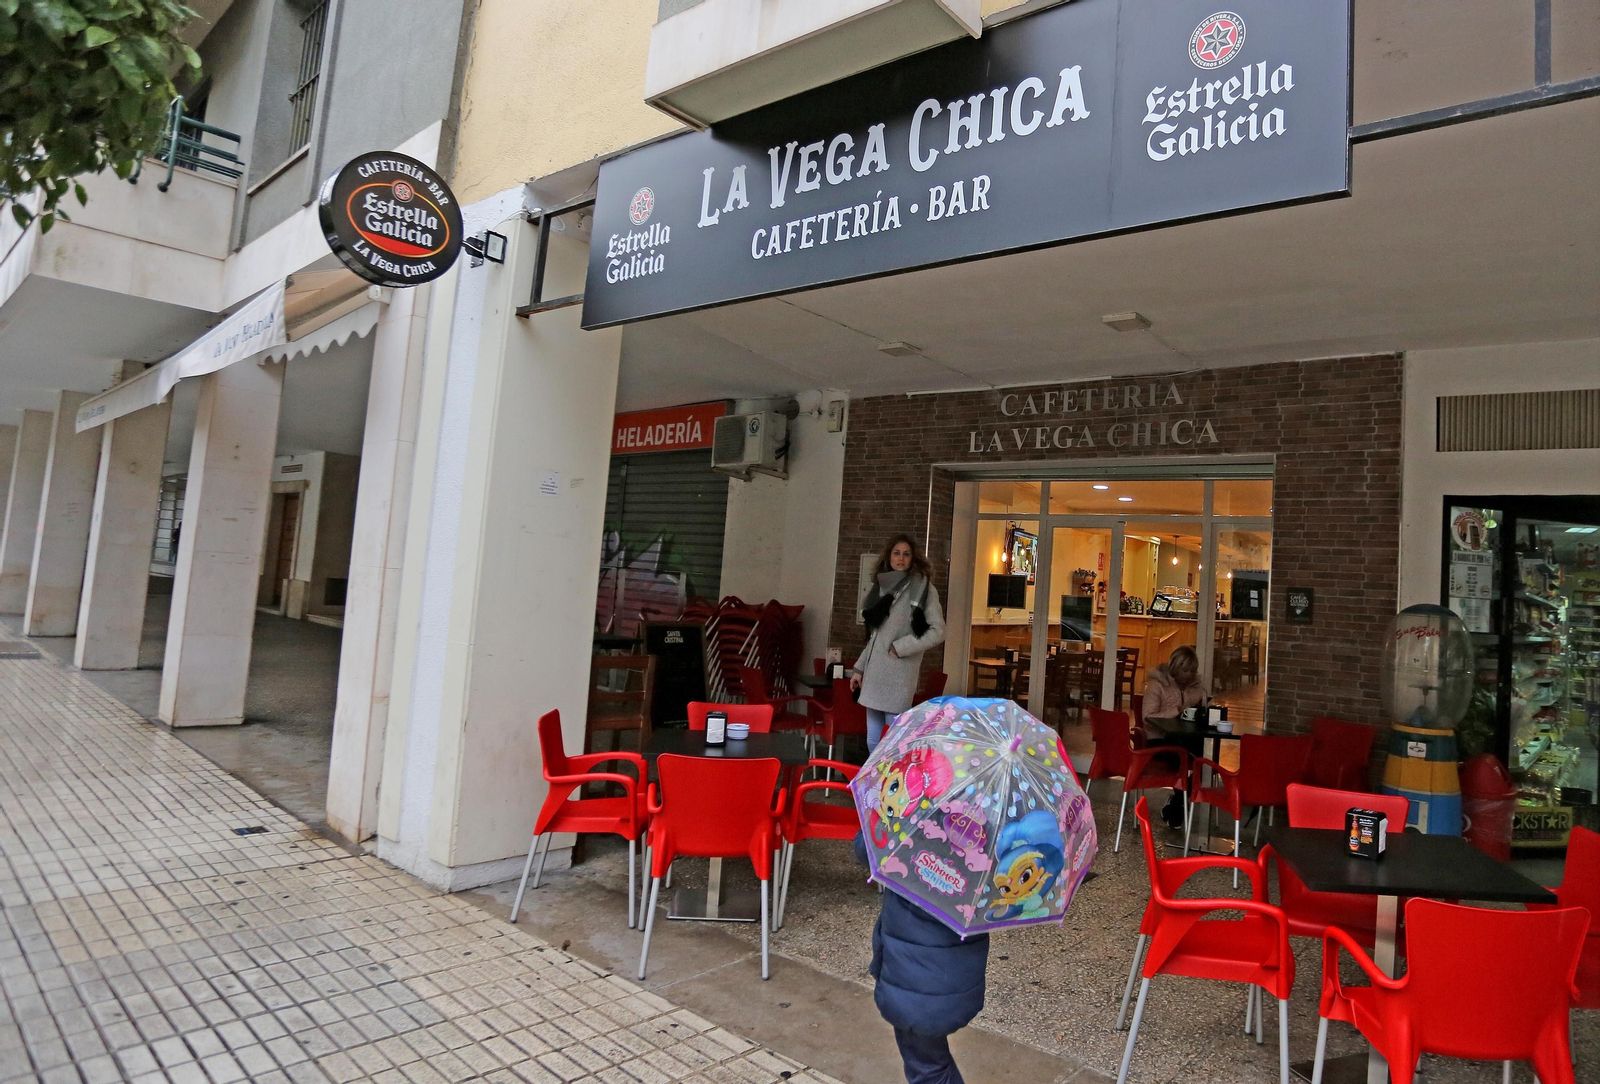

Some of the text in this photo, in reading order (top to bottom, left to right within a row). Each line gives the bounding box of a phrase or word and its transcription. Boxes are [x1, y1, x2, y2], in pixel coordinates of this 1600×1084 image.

[1141, 60, 1295, 126] Estrella
[697, 164, 750, 229] LA
[767, 122, 891, 209] VEGA
[908, 65, 1091, 173] CHICA
[1146, 103, 1287, 162] Galicia
[357, 160, 450, 207] CAFETERÍA BAR
[362, 192, 438, 231] Estrella
[365, 211, 434, 248] Galicia
[751, 174, 991, 260] CAFETERÍA BAR
[352, 239, 437, 278] LA VEGA CHICA
[606, 222, 671, 259] Estrella
[606, 249, 665, 284] Galicia
[1000, 381, 1184, 417] CAFETERIA
[616, 414, 702, 449] HELADERÍA
[968, 419, 1219, 453] LA VEGA CHICA
